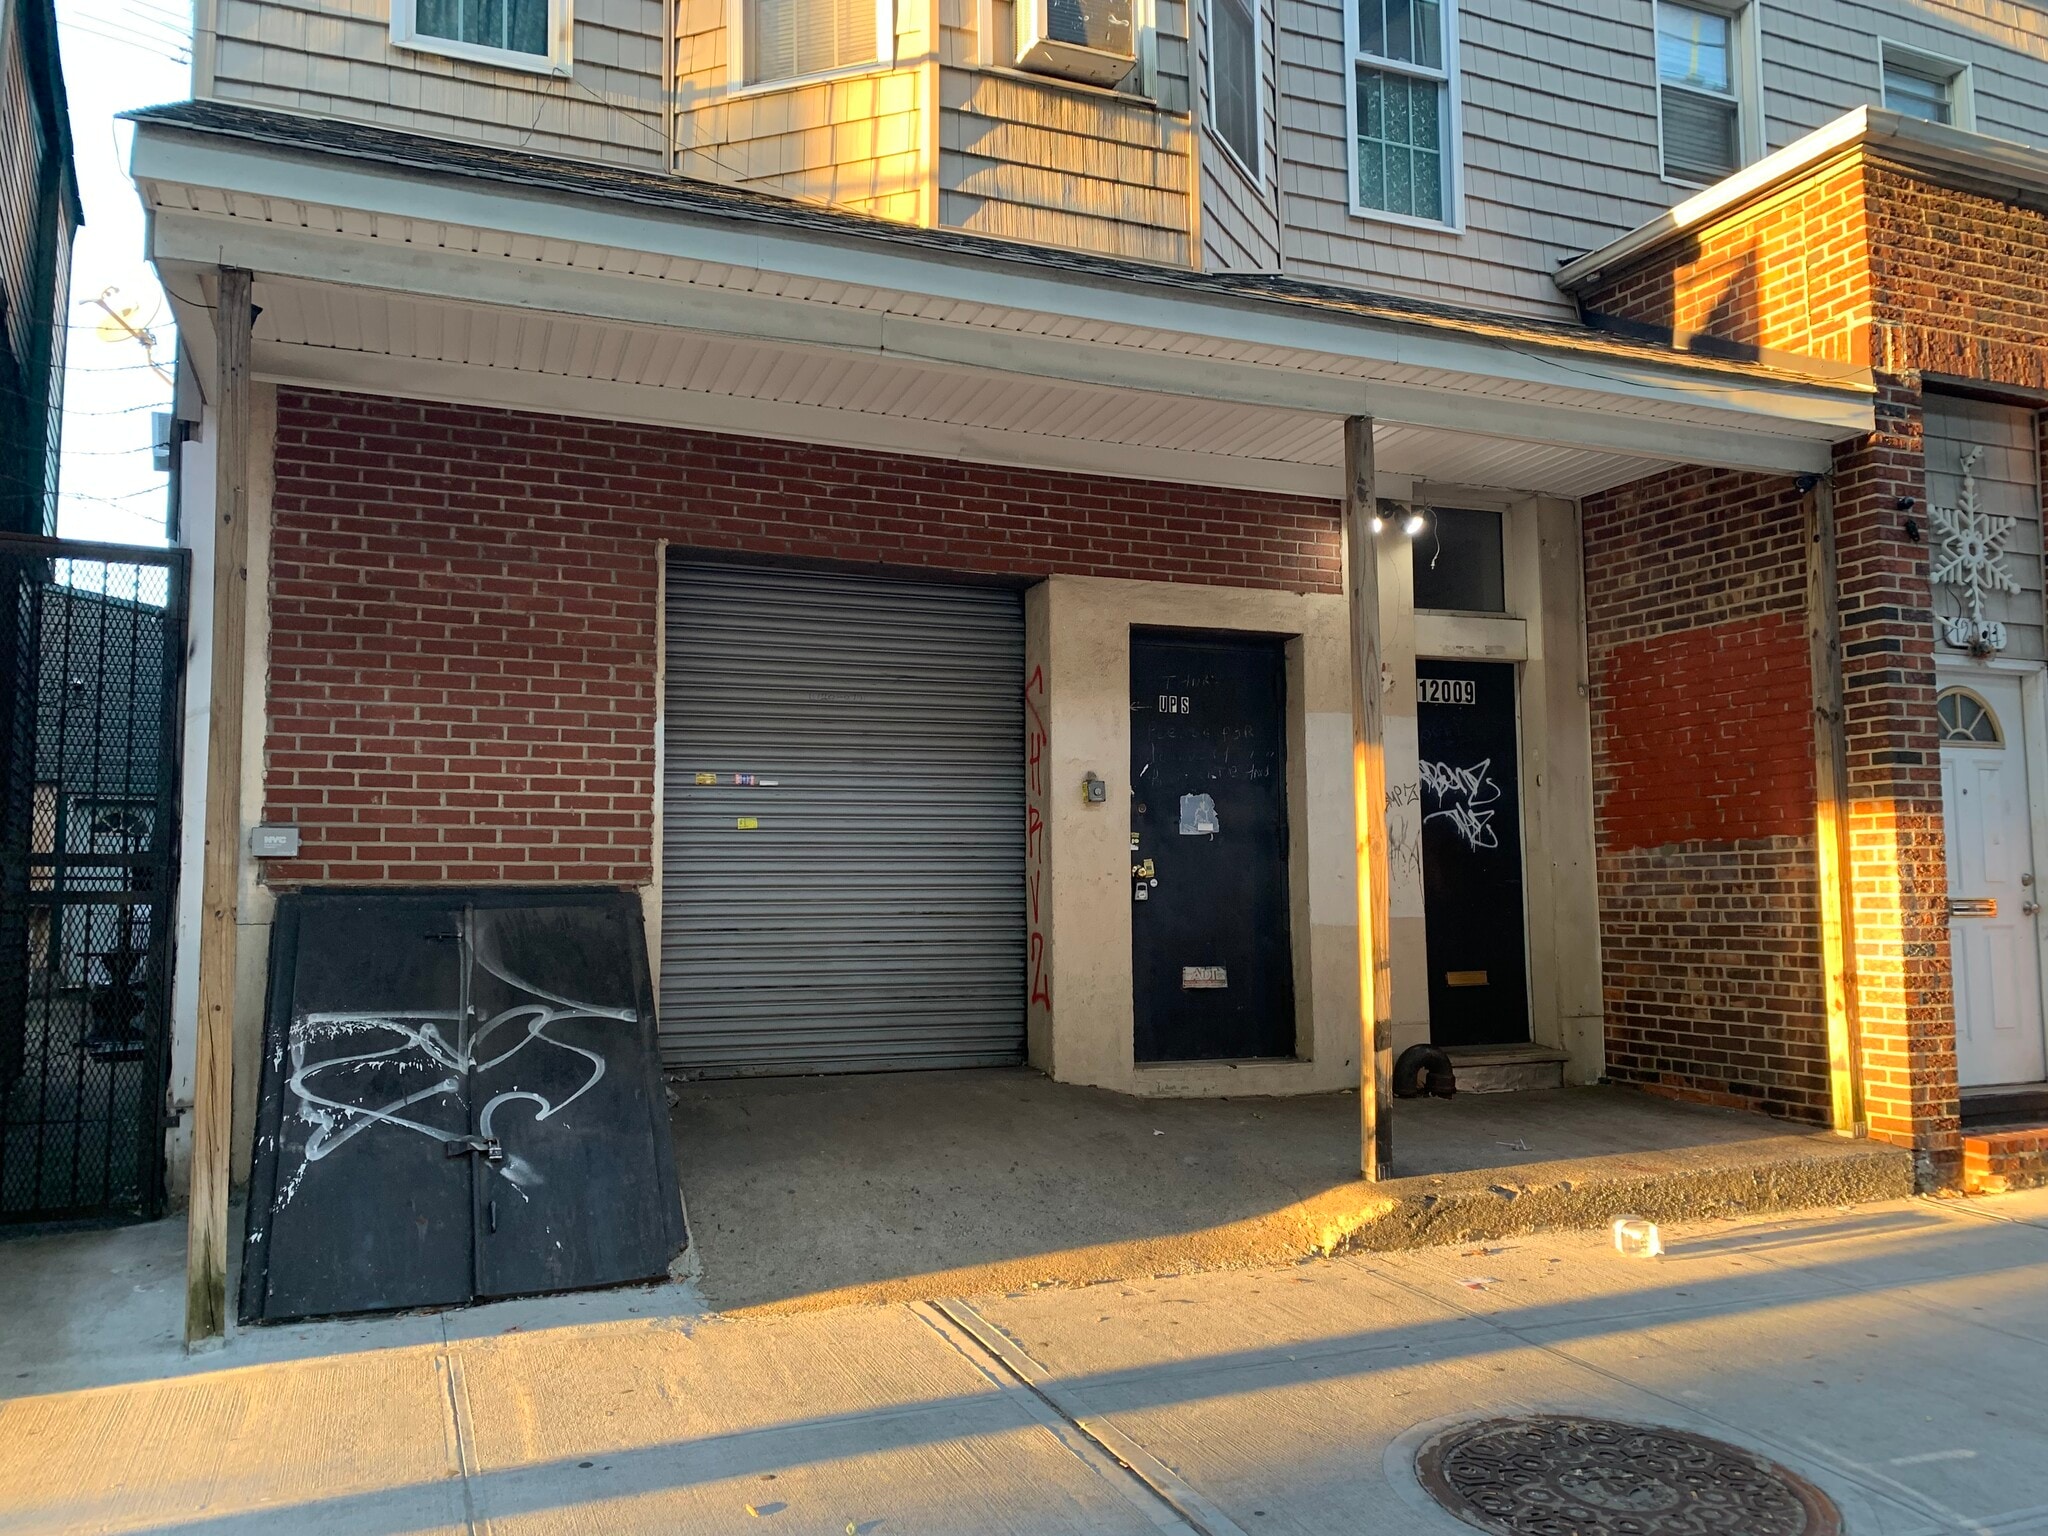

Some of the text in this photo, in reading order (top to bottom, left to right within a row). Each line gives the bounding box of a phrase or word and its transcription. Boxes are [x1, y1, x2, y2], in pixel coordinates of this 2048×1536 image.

[1419, 679, 1474, 704] 12009
[1159, 695, 1190, 714] UPS
[263, 835, 287, 844] NYC
[1190, 967, 1218, 981] ADT
